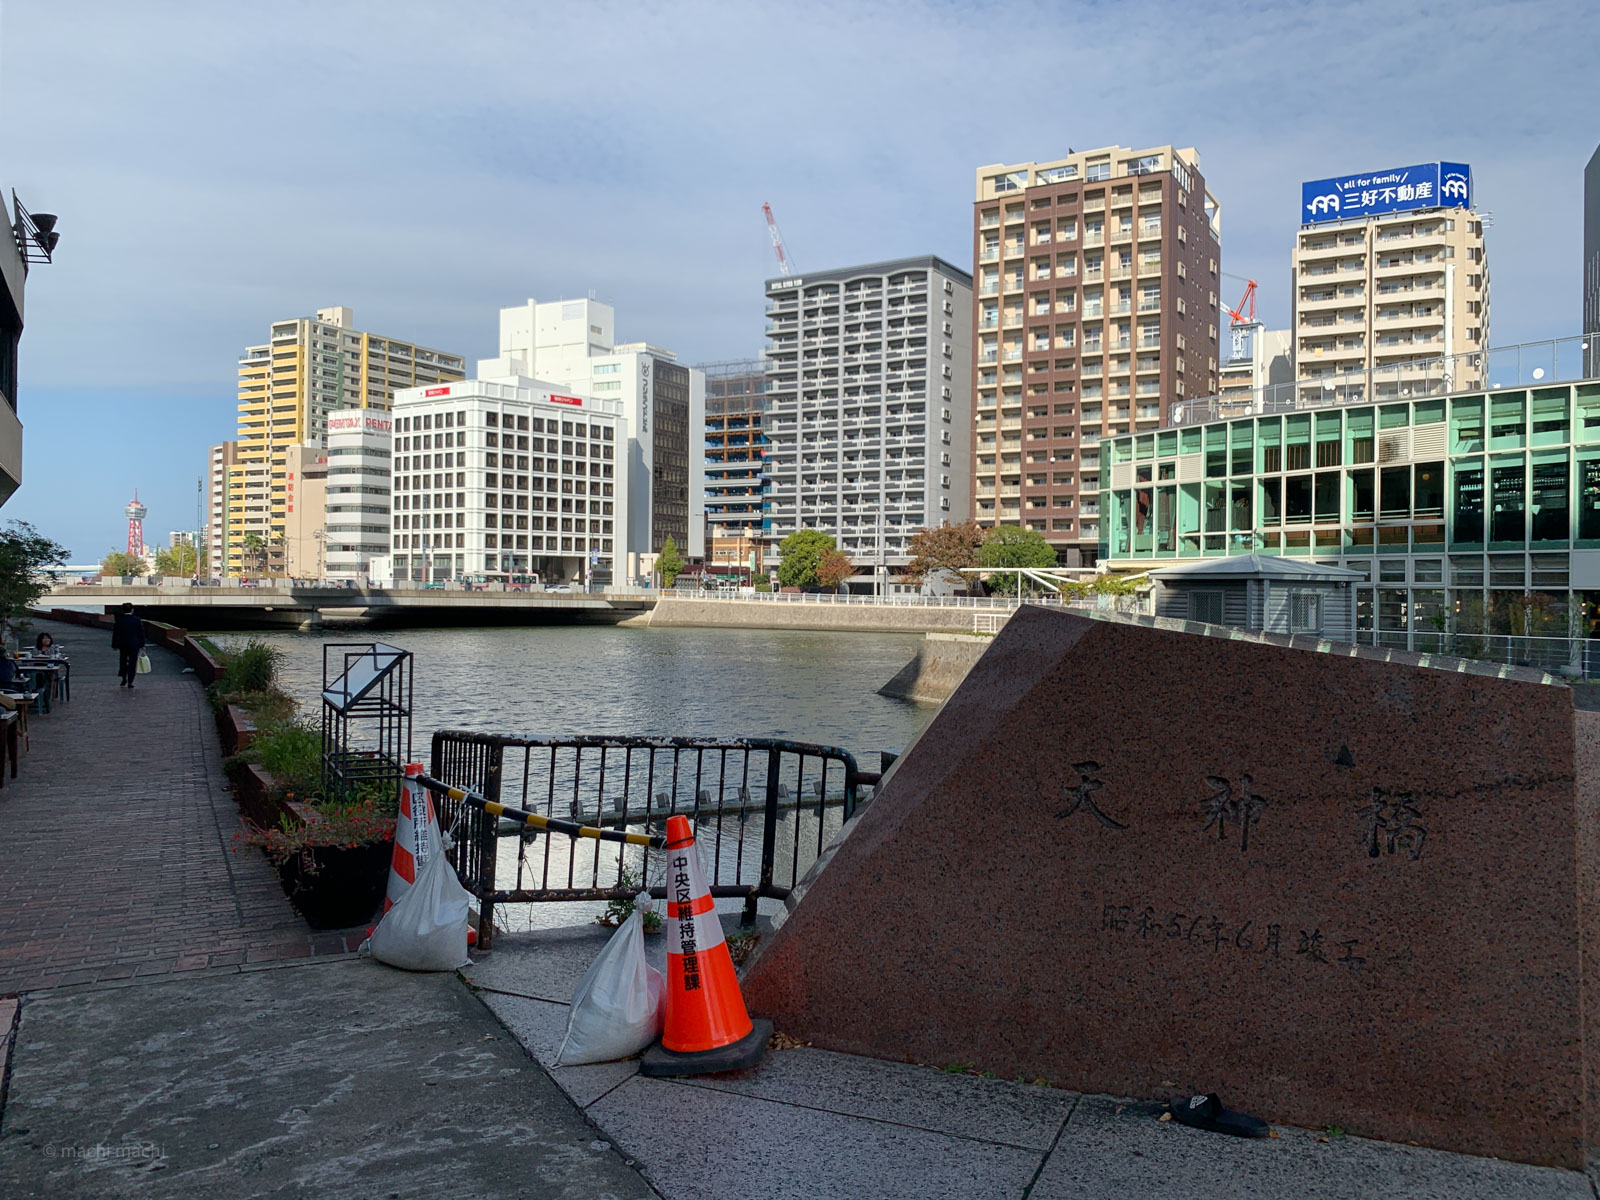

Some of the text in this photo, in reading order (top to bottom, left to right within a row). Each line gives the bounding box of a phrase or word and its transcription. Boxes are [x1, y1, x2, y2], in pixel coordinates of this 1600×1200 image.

[1343, 174, 1401, 189] all for family
[1343, 181, 1433, 210] 三好不動産
[1054, 760, 1428, 862] 天神橋
[672, 856, 701, 991] 中央区維持管理課
